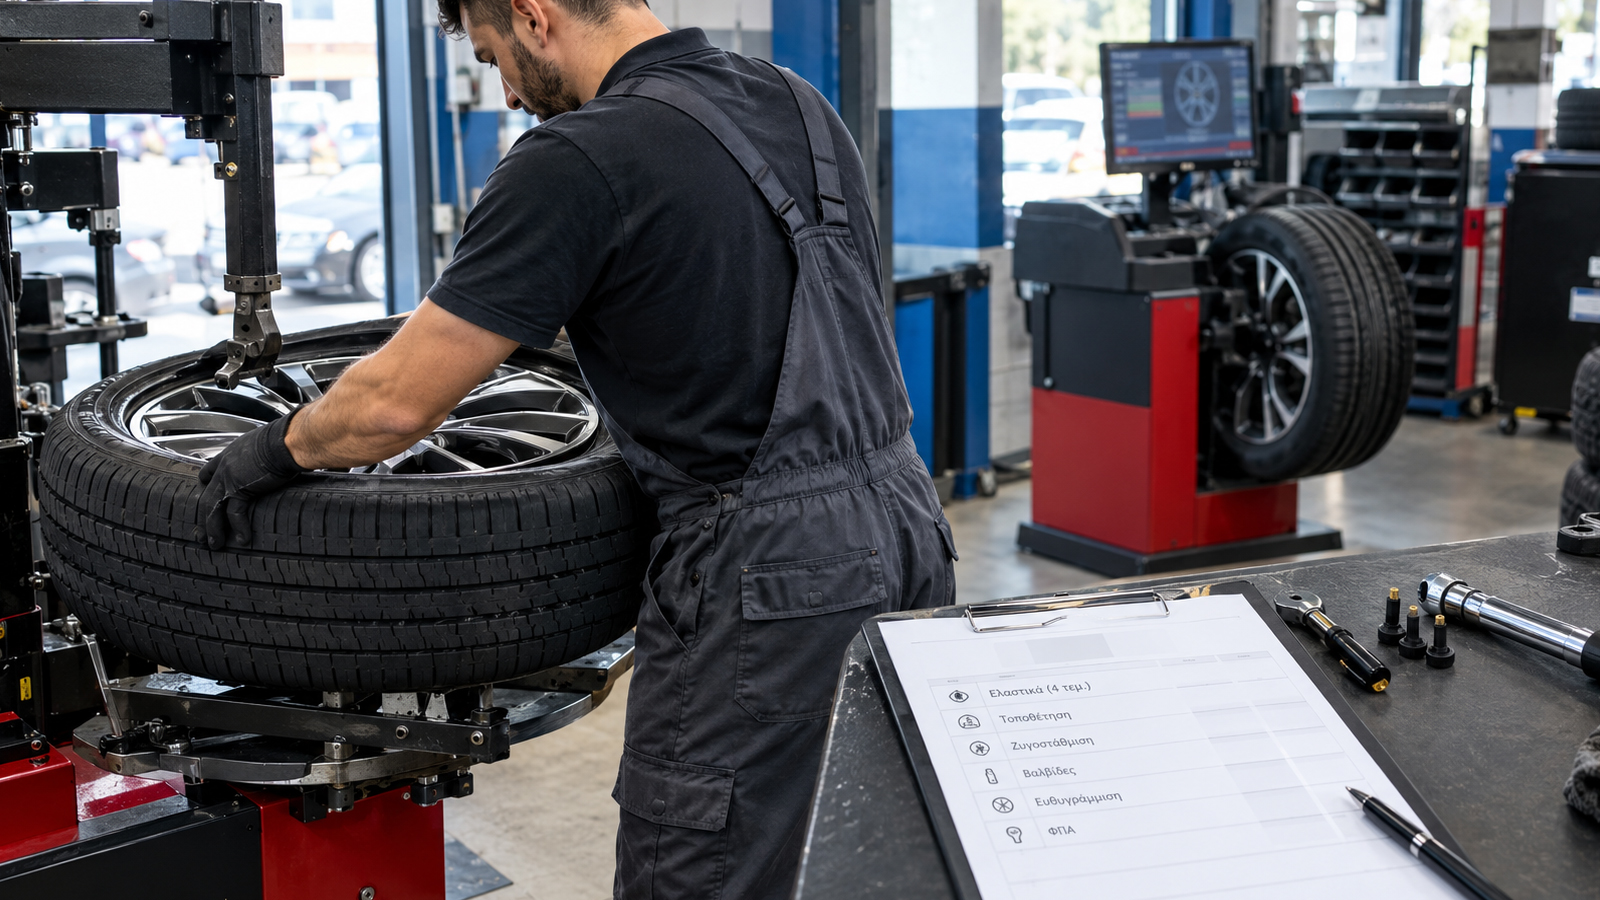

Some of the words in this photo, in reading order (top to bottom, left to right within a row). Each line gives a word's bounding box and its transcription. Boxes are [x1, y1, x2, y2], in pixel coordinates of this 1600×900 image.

[989, 686, 1044, 698] Ελαστικά
[1047, 684, 1059, 695] (4
[1062, 682, 1092, 693] τεμ.)
[999, 711, 1073, 724] Τοποθέτηση
[1011, 737, 1095, 752] Ζυγοστάθμιση
[1022, 766, 1077, 779] Βαλβίδες
[1035, 792, 1123, 807] Ευθυγράμμιση
[1048, 825, 1076, 836] ΦΠΑ
